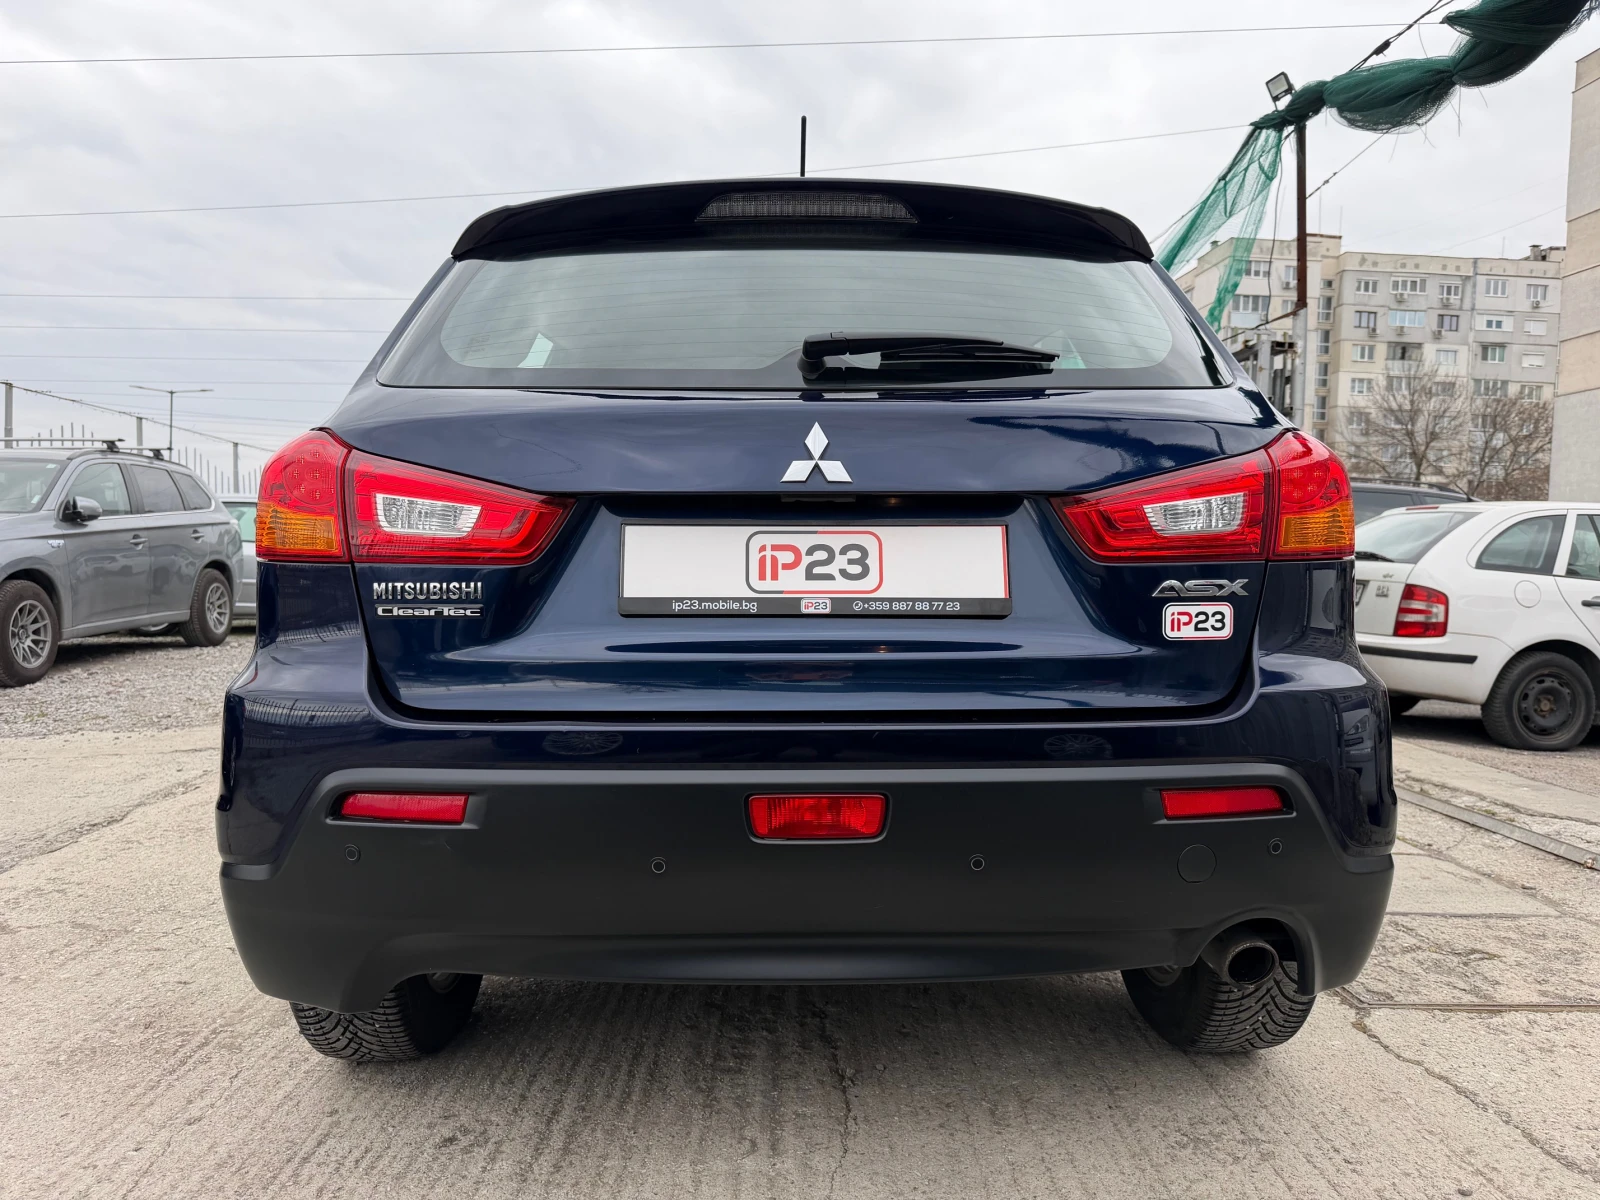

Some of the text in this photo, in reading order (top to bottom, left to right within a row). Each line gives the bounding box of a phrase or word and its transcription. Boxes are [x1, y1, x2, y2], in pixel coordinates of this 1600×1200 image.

[373, 582, 482, 600] MITSUBISHI
[1152, 579, 1249, 597] ASX
[377, 605, 481, 616] ClearTec
[672, 600, 758, 613] ip23.mobile.bg
[863, 602, 961, 611] +359 887 88 77 23
